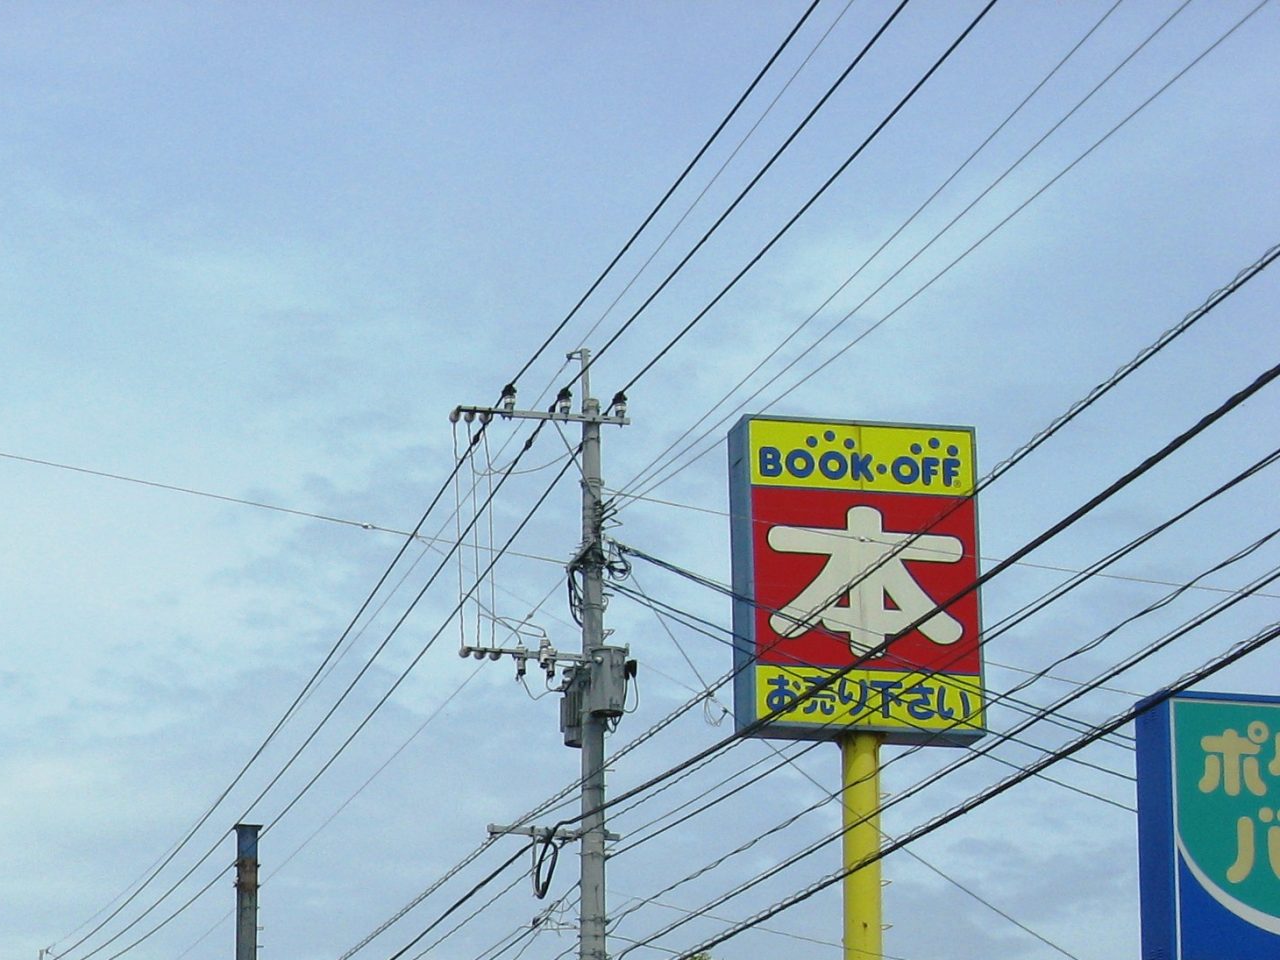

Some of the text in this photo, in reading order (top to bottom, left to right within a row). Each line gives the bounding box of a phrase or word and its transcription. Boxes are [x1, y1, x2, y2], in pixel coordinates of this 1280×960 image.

[767, 505, 963, 659] 本
[766, 675, 971, 719] お売り下さい
[1198, 720, 1280, 797] ポ
